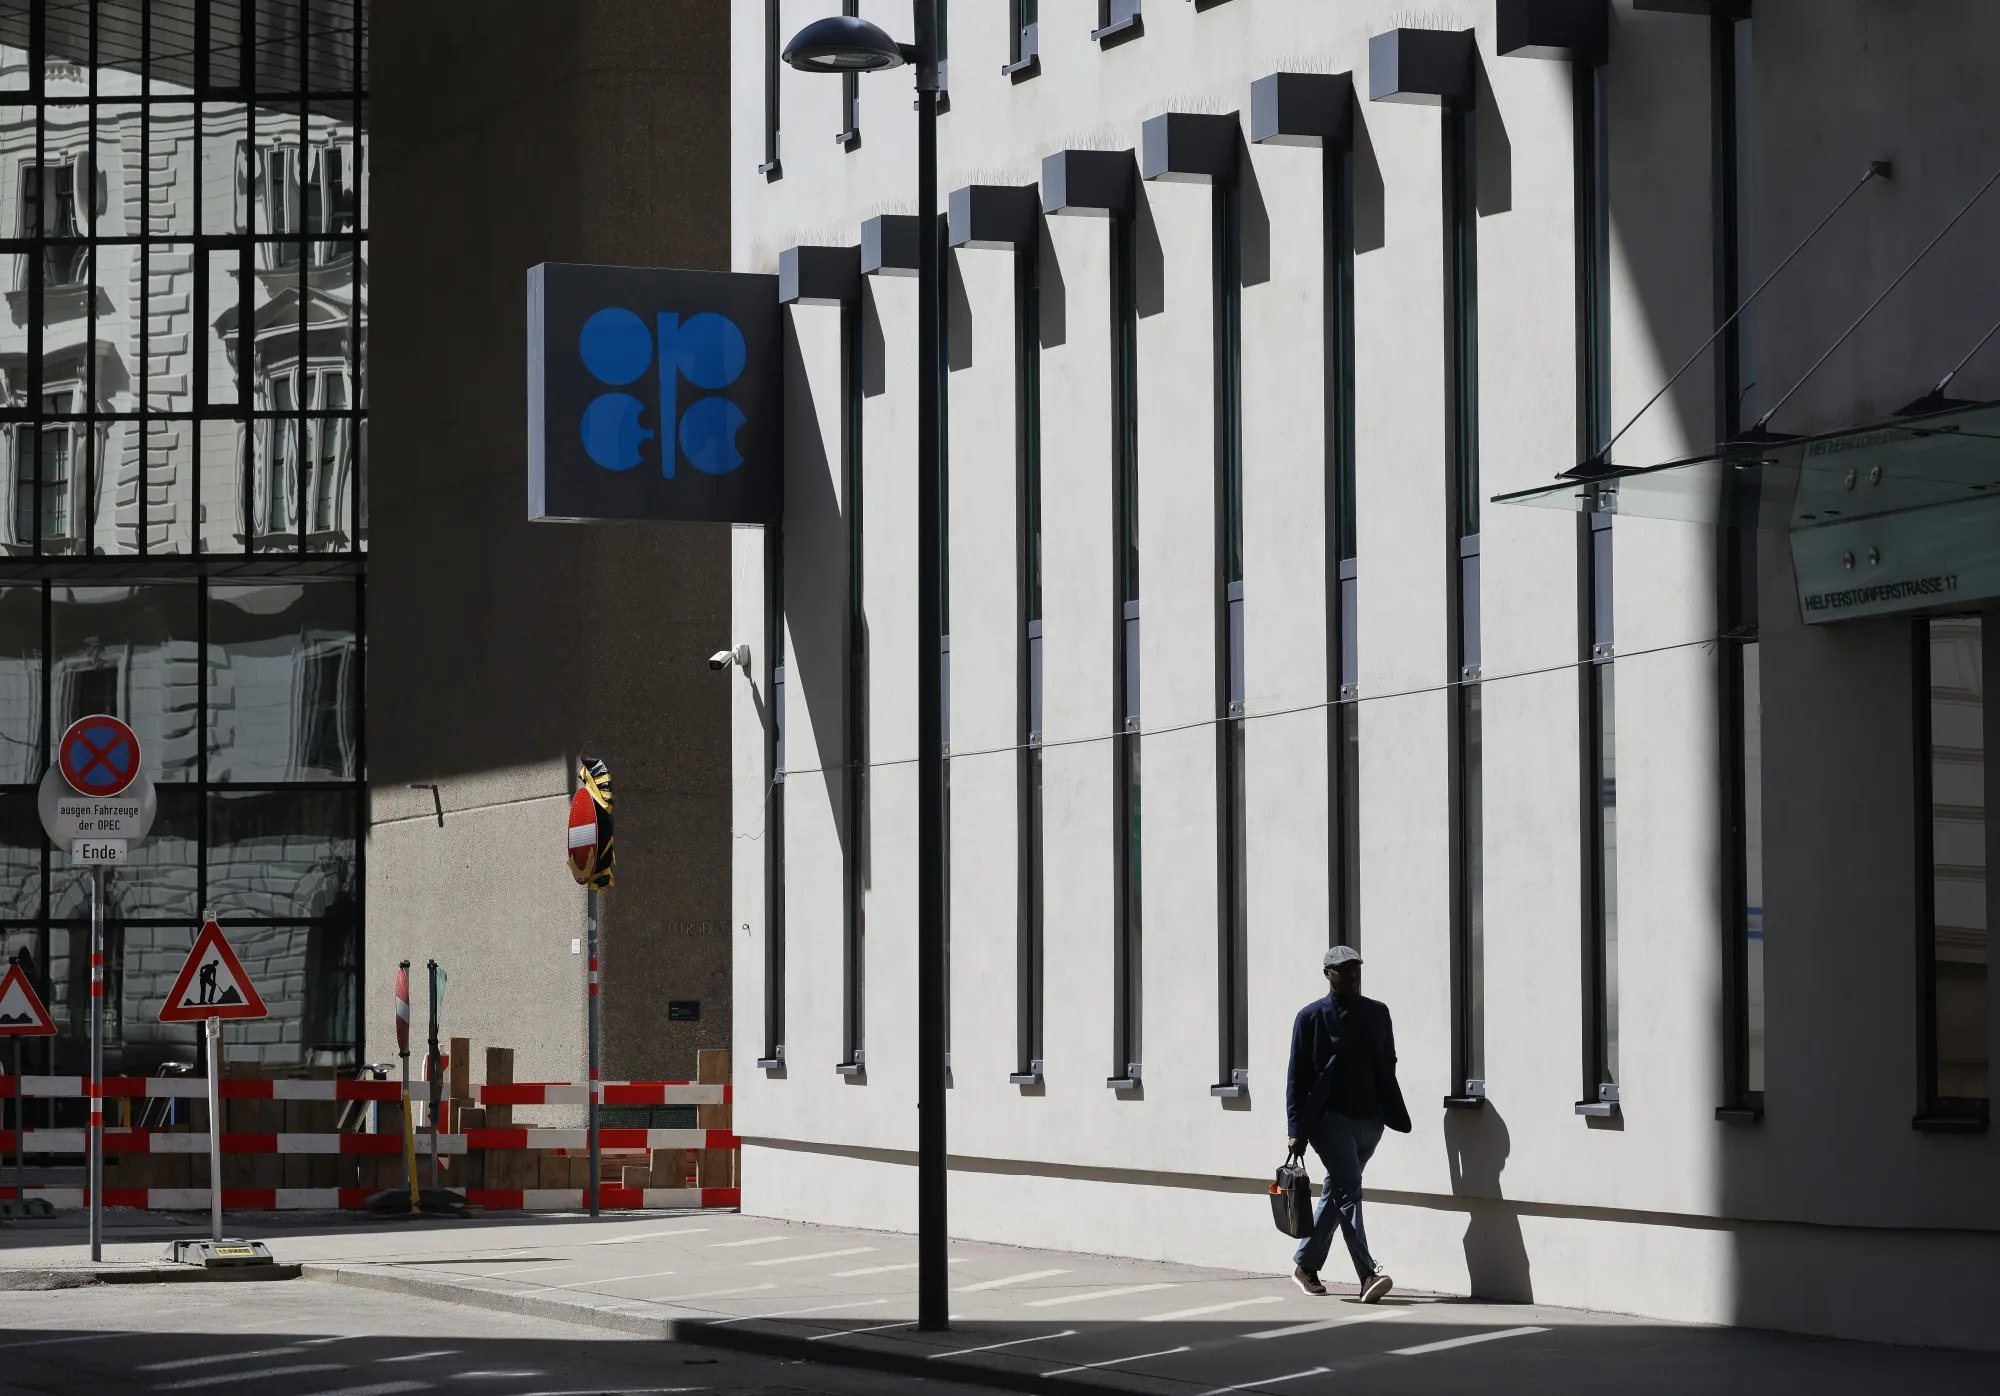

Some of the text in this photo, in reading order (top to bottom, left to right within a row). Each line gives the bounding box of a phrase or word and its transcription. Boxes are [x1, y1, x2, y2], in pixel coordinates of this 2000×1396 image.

[1805, 575, 1958, 611] HELFERSTORFERSTRASSE 17
[61, 805, 138, 817] ausgen. Fahrzeuge
[79, 820, 120, 830] der OPEC
[83, 844, 116, 859] Ende
